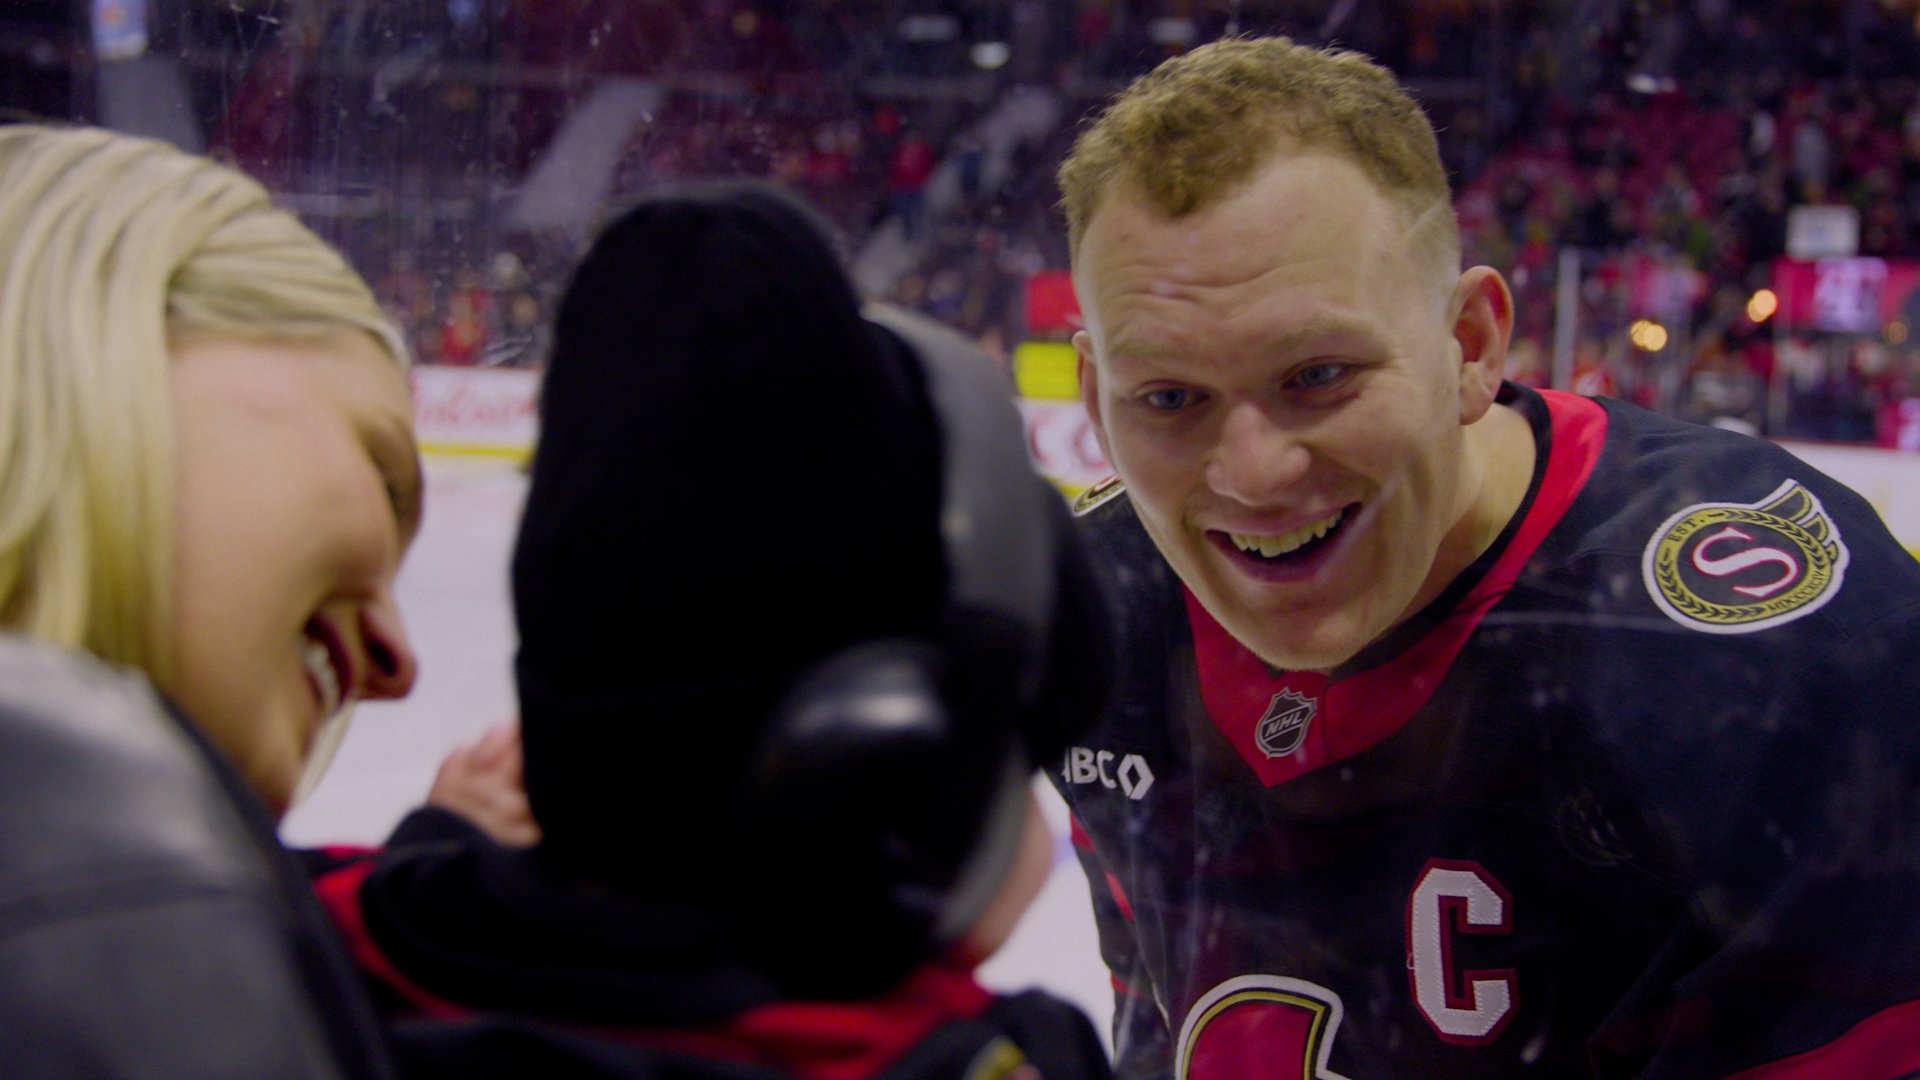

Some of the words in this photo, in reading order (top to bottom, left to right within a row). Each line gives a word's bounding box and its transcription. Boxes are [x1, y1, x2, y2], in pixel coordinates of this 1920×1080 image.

[1667, 517, 1705, 542] EST.
[1690, 526, 1798, 598] S
[1264, 710, 1303, 738] NHL
[1404, 857, 1521, 1047] C
